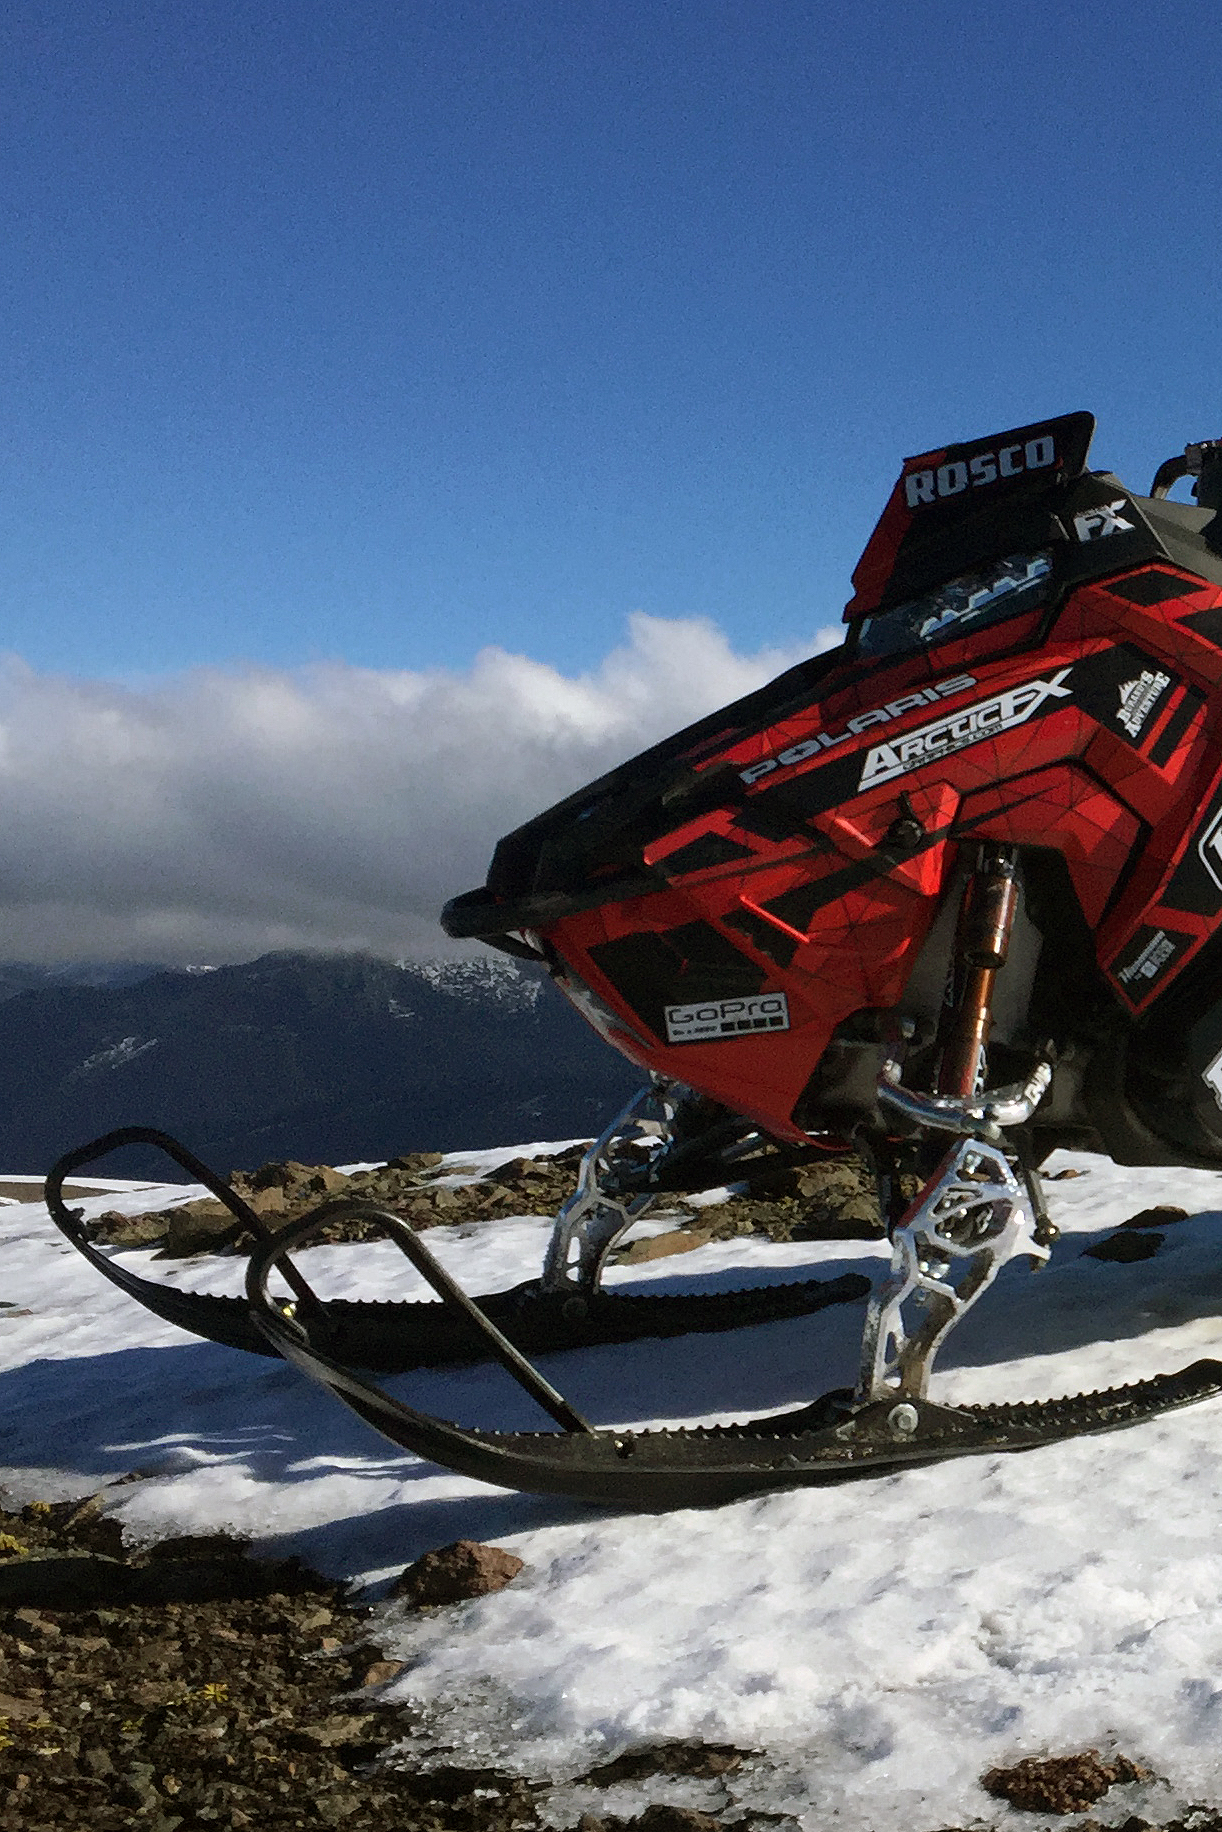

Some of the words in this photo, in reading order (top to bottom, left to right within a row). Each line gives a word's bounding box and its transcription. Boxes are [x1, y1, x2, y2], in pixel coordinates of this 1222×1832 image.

[904, 436, 1055, 508] ROSCO
[1073, 499, 1136, 543] FX
[738, 673, 978, 785] POLARIS
[668, 999, 783, 1025] GoPro
